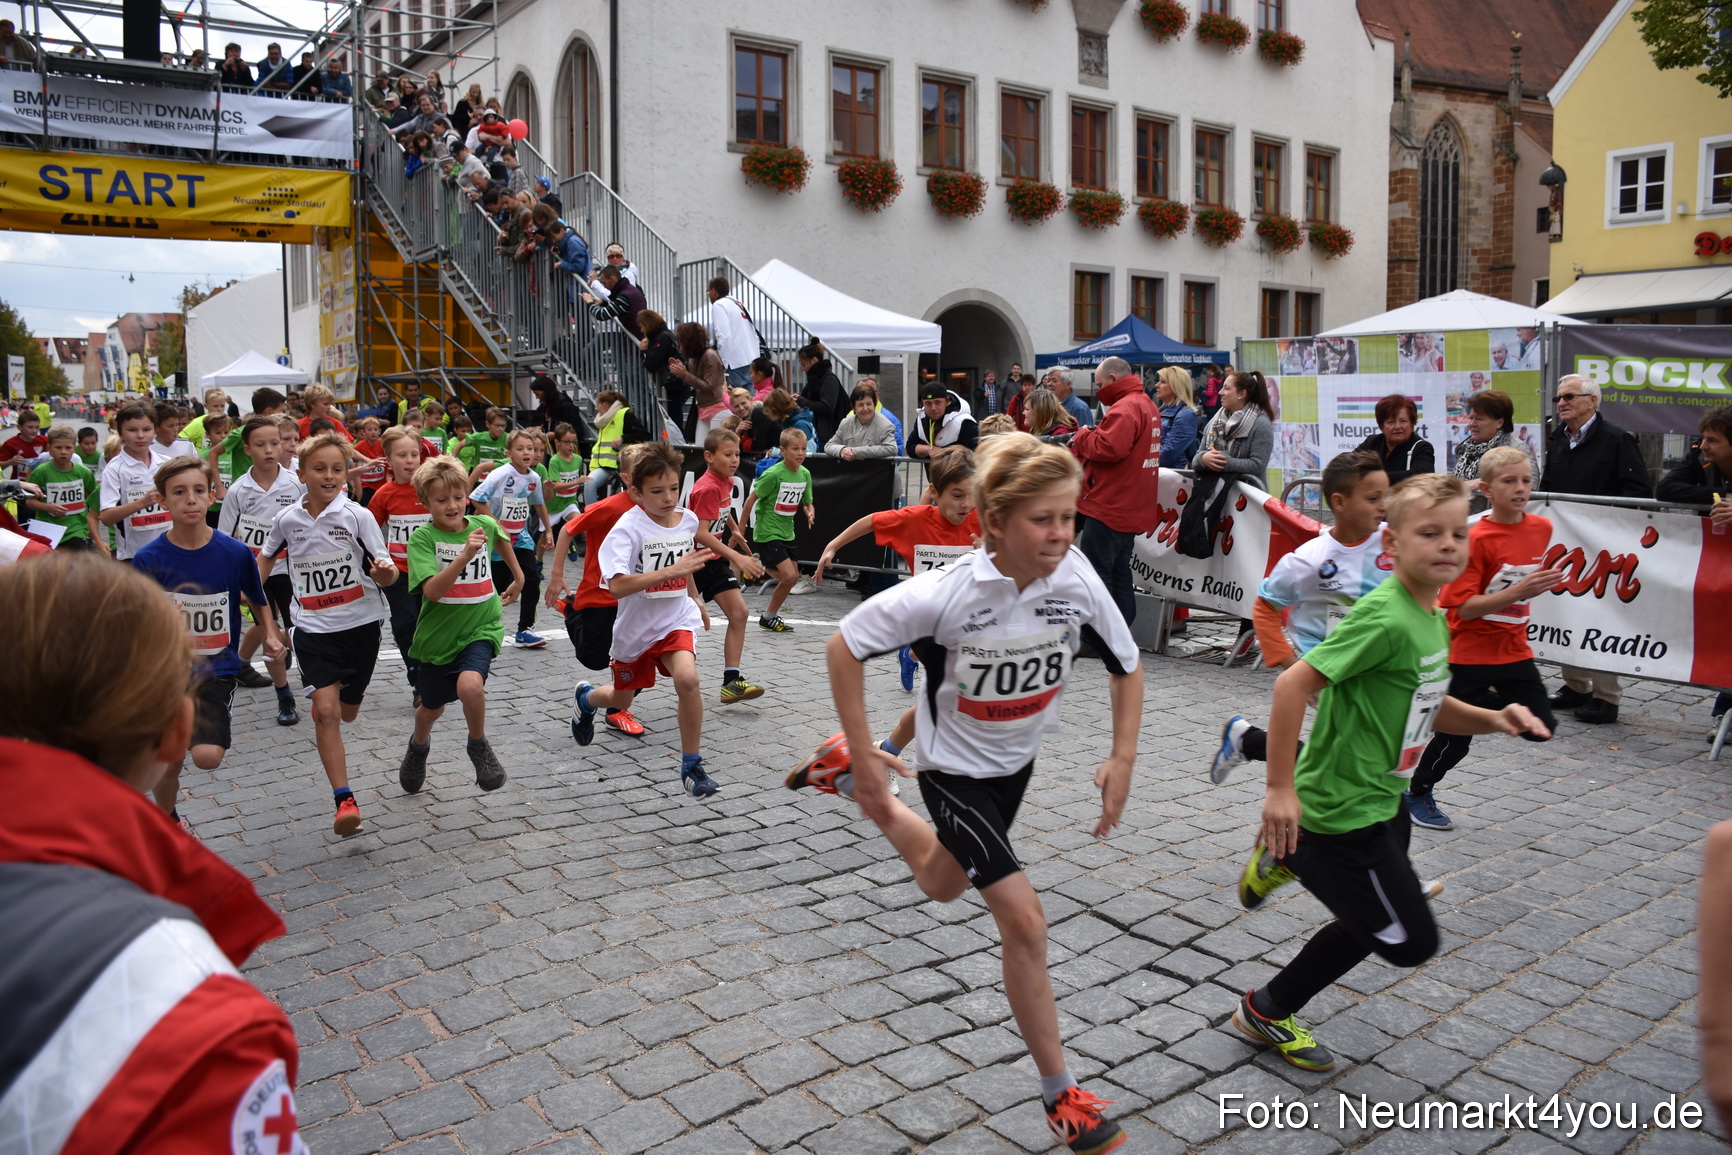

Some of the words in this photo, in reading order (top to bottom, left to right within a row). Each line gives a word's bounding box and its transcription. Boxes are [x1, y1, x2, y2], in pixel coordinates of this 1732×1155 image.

[13, 90, 61, 107] BMW
[64, 95, 247, 125] EFFICIENTDYNAMCS.
[14, 107, 68, 120] WENGER
[70, 113, 141, 128] VERBRAUCH.
[144, 120, 175, 130] MEHR
[39, 164, 205, 208] START
[233, 196, 284, 206] Neumarkter
[286, 199, 326, 208] Stadtlauf
[1576, 357, 1728, 391] BOCK
[138, 381, 145, 391] A
[1621, 392, 1634, 405] by
[1639, 394, 1670, 405] smart
[1333, 423, 1378, 438] Neuer
[51, 489, 82, 503] 7405
[782, 491, 804, 503] 721
[241, 518, 258, 528] PARTL
[437, 547, 459, 557] PARTL
[644, 542, 665, 550] PARTL
[916, 550, 938, 558] PARTL
[312, 557, 344, 567] Neumarkt
[300, 565, 355, 593] 7022
[1201, 575, 1244, 601] Radio
[181, 600, 217, 608] Neumarkt
[318, 596, 345, 607] Lukas
[961, 645, 1002, 659] PARTL
[1004, 639, 1058, 657] Neumarkt
[1580, 628, 1668, 660] Radio
[970, 651, 1063, 697] 7028
